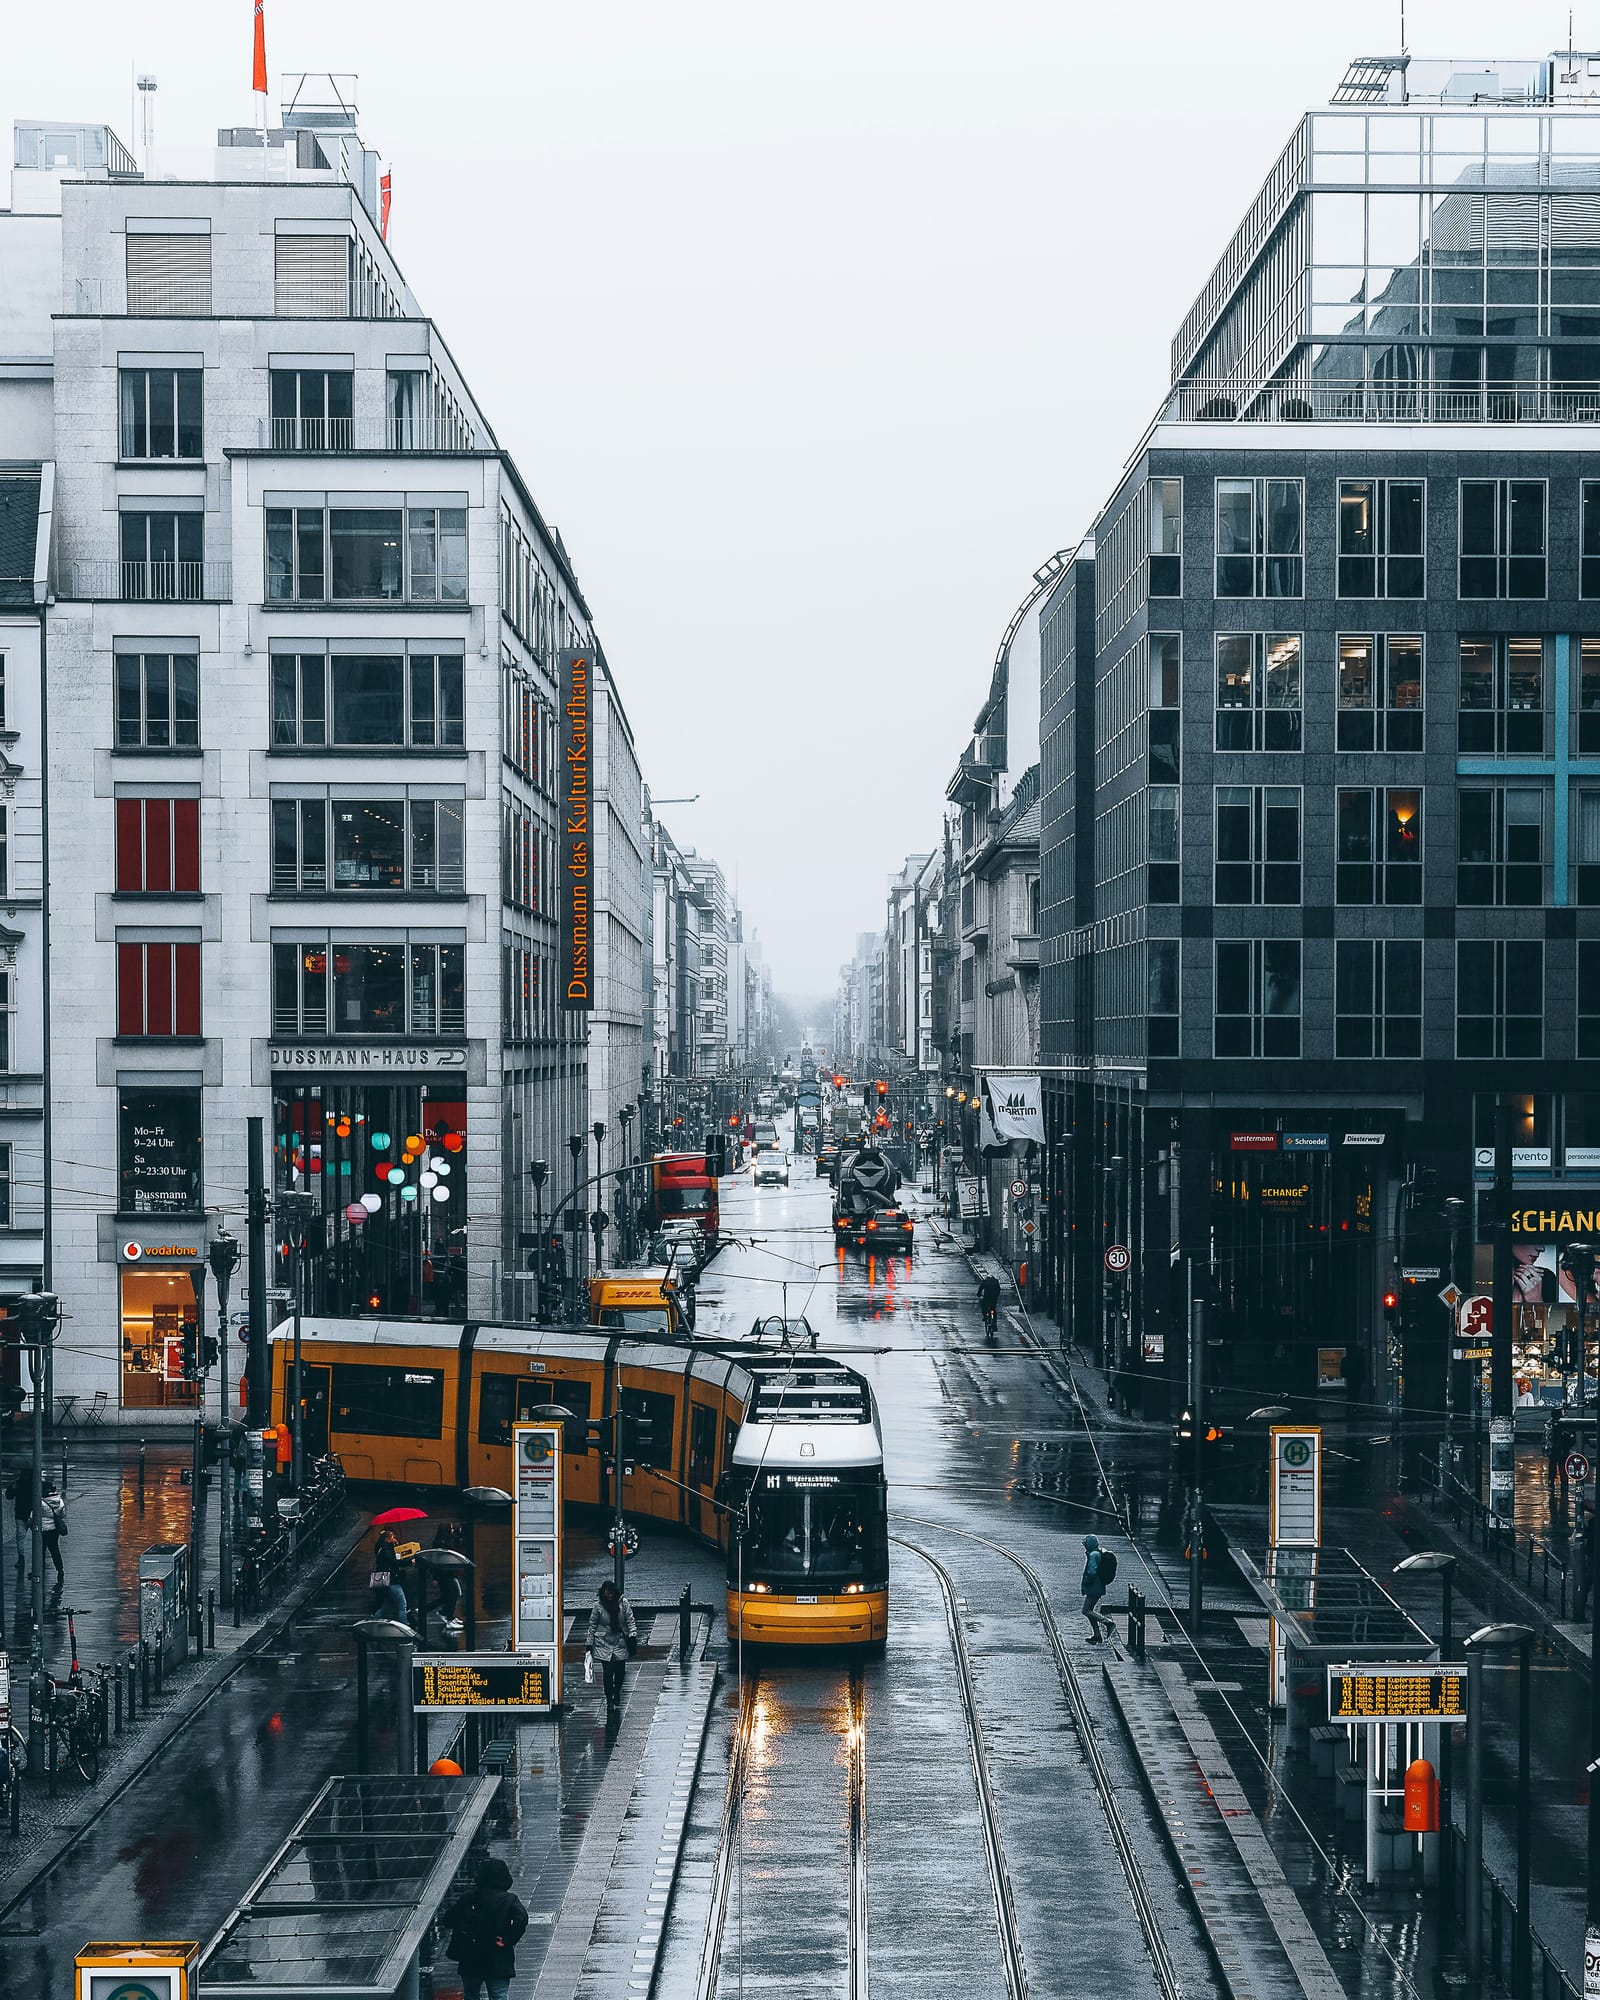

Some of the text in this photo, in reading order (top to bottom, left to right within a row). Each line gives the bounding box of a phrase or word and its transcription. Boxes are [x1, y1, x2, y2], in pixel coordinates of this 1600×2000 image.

[567, 658, 587, 1000] Dussmann das KulturKaufhaus
[271, 1050, 429, 1065] DUSSMANN-HAUS
[159, 1139, 174, 1147] Uhr
[1347, 1136, 1381, 1144] Diesterweg
[134, 1155, 145, 1164] Sa
[171, 1167, 187, 1175] Uhr
[1014, 1185, 1023, 1193] 30
[135, 1190, 187, 1199] Dussmann
[145, 1245, 197, 1256] vodafone
[1110, 1253, 1126, 1265] 30
